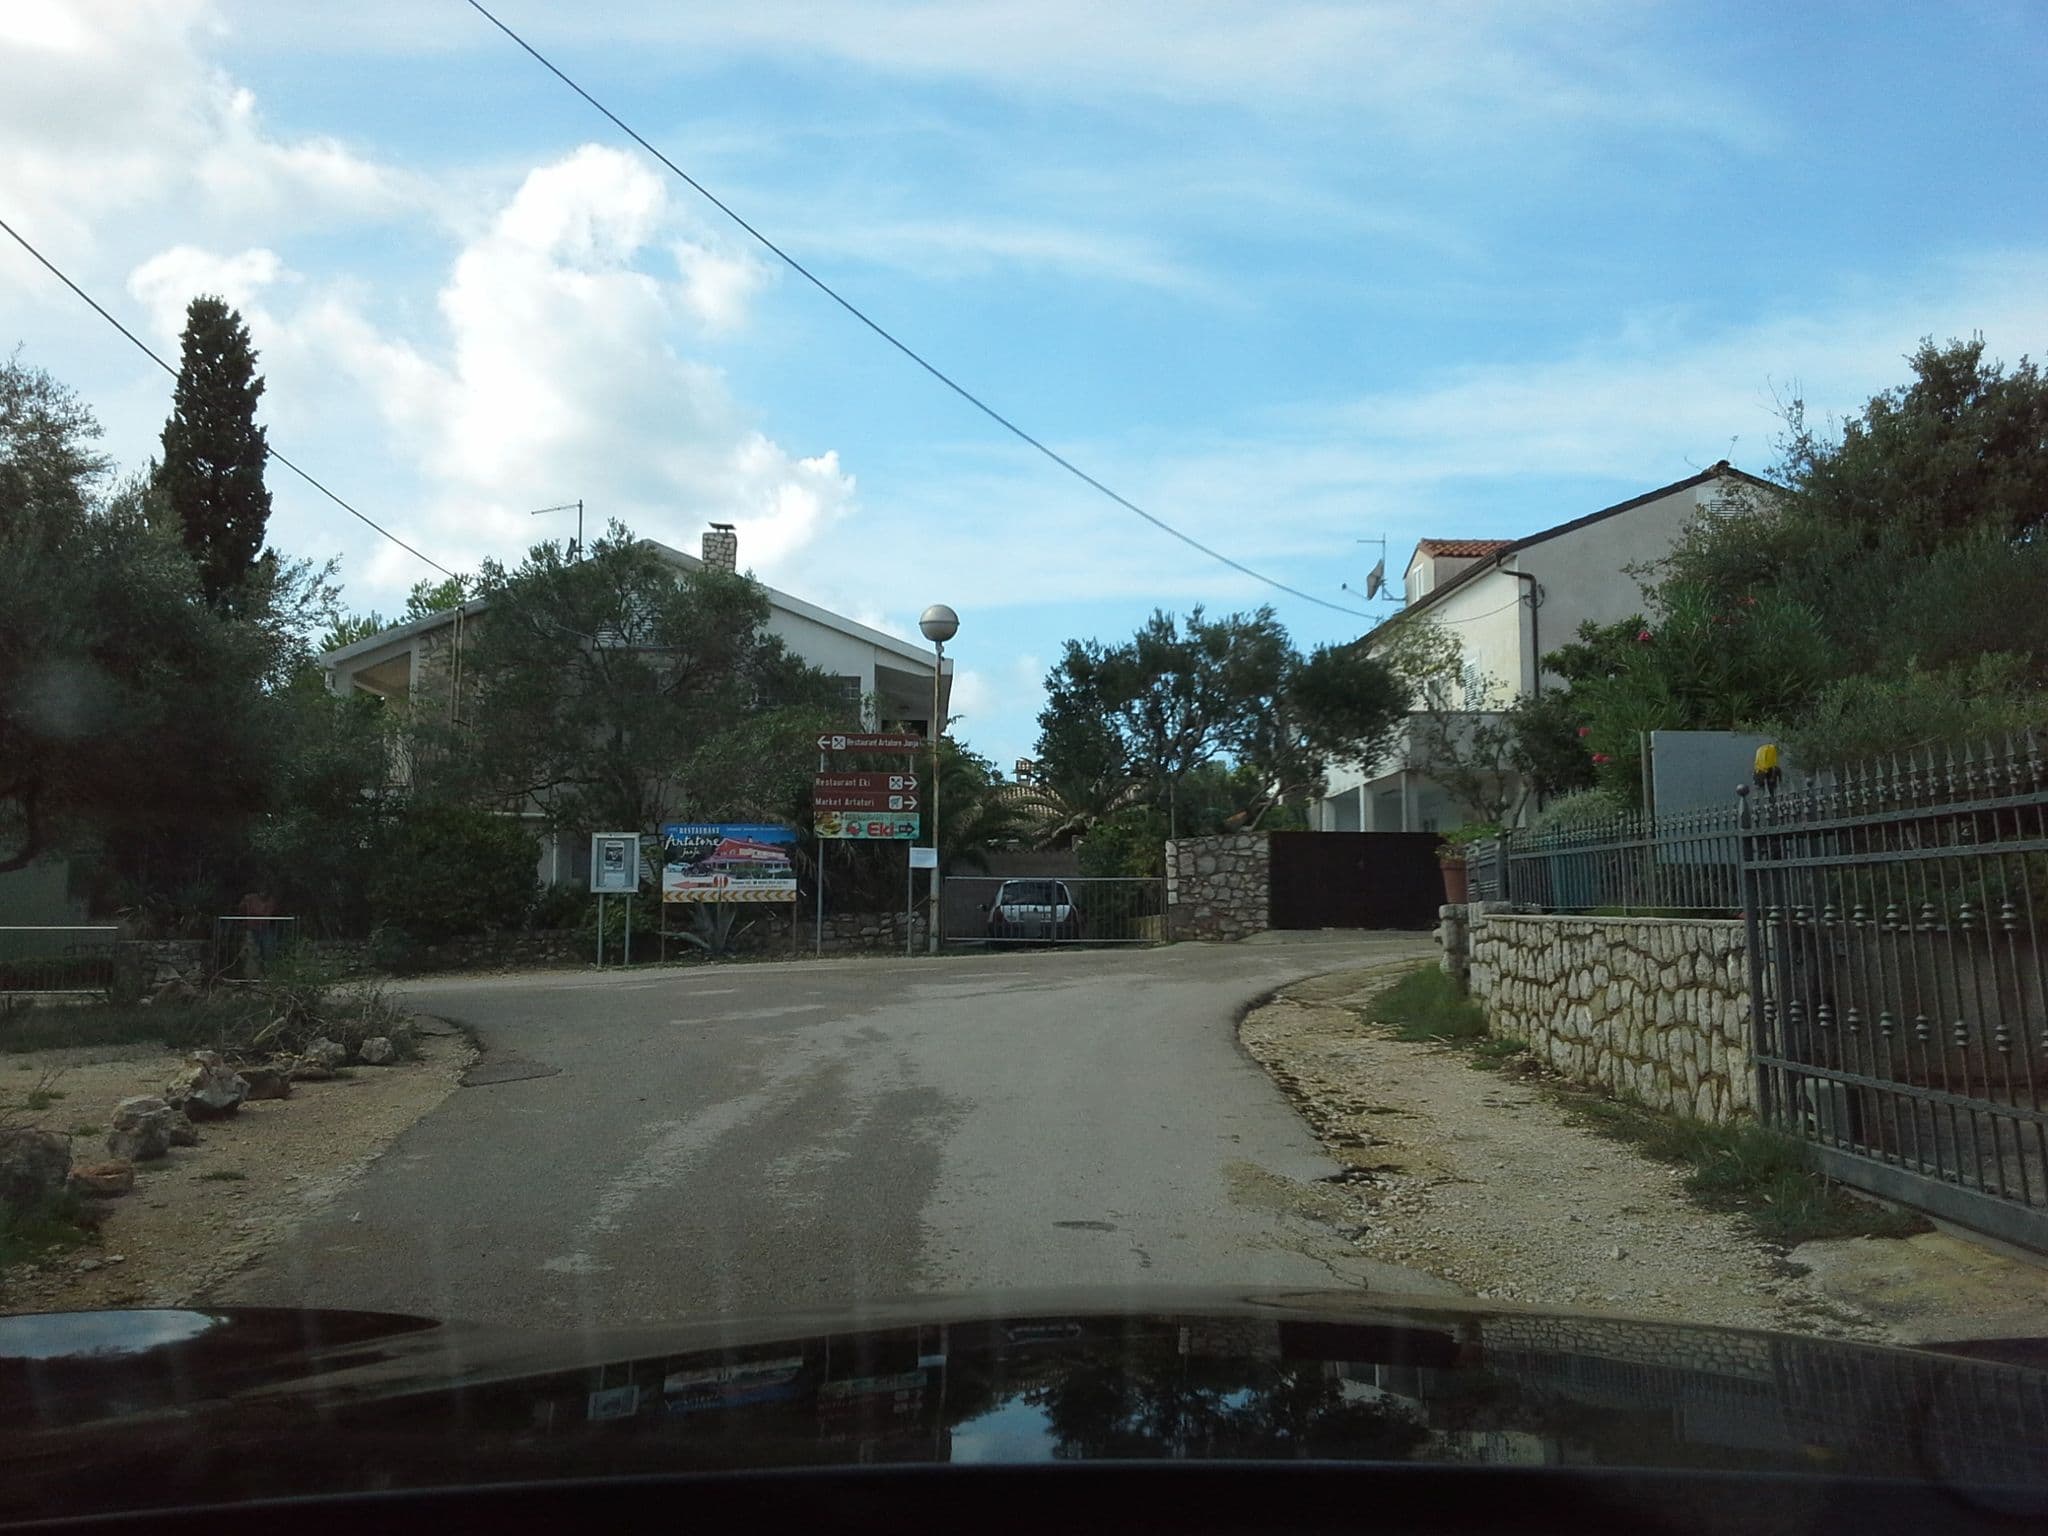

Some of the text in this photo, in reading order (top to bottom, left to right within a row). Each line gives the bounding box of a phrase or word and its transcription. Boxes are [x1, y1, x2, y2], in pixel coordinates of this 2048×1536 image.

[847, 738, 878, 747] Restaurant
[815, 778, 871, 787] Restaurant Eki
[815, 797, 842, 806] Market
[665, 833, 721, 850] Artatore
